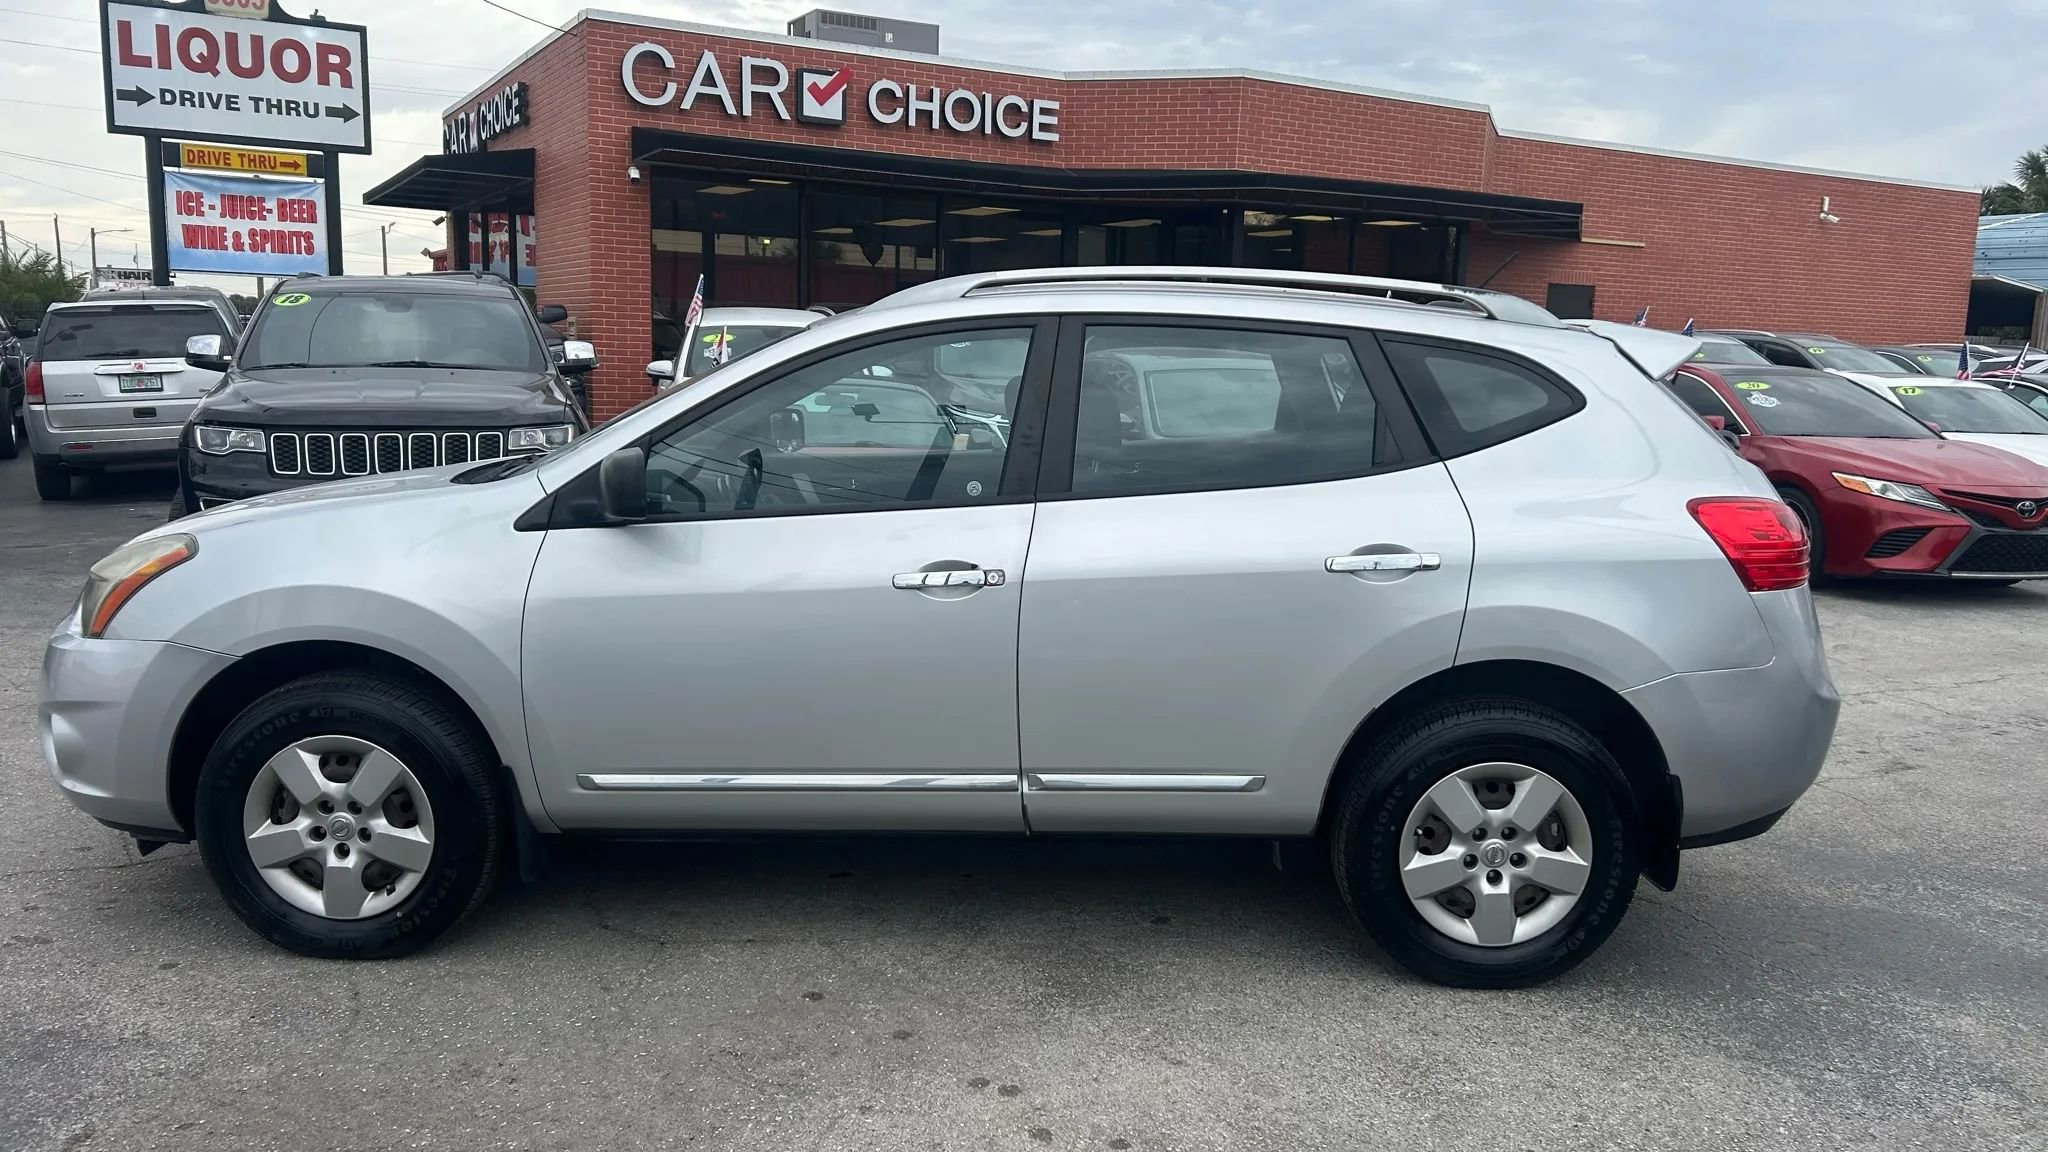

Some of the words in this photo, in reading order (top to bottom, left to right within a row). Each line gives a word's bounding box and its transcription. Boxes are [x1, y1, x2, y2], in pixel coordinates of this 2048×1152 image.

[117, 20, 354, 89] LIQUOR
[158, 87, 241, 111] DRIVE
[248, 96, 320, 118] THRU
[621, 41, 791, 120] CAR
[867, 78, 1060, 142] CHOICE
[480, 82, 520, 141] CHOICE
[186, 148, 232, 167] DRIVE
[238, 153, 277, 170] THRU
[175, 190, 205, 217] ICE
[276, 197, 318, 224] BEER
[181, 223, 228, 251] WINE
[231, 230, 245, 252] &
[247, 227, 314, 256] SPIRITS
[117, 270, 153, 281] HAIR
